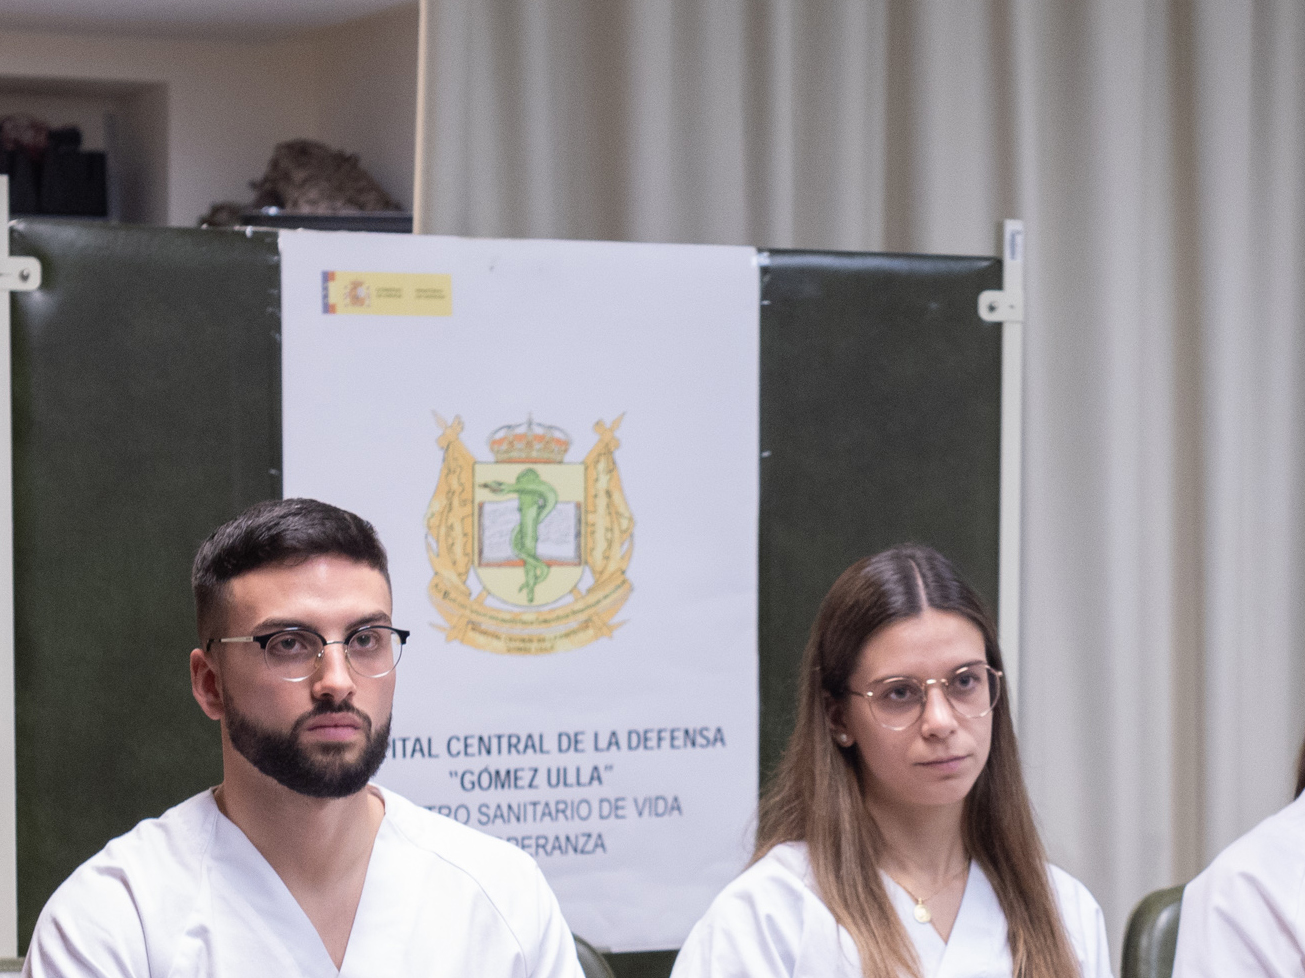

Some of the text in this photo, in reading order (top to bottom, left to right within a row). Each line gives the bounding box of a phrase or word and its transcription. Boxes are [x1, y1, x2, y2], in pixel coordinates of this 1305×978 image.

[391, 725, 727, 760] ITAL CENTRAL DE LA DEFENSA
[449, 763, 614, 792] "GÓMEZ ULLA"
[476, 798, 593, 826] SANITARIO
[598, 796, 628, 820] DE
[633, 794, 683, 819] VIDA
